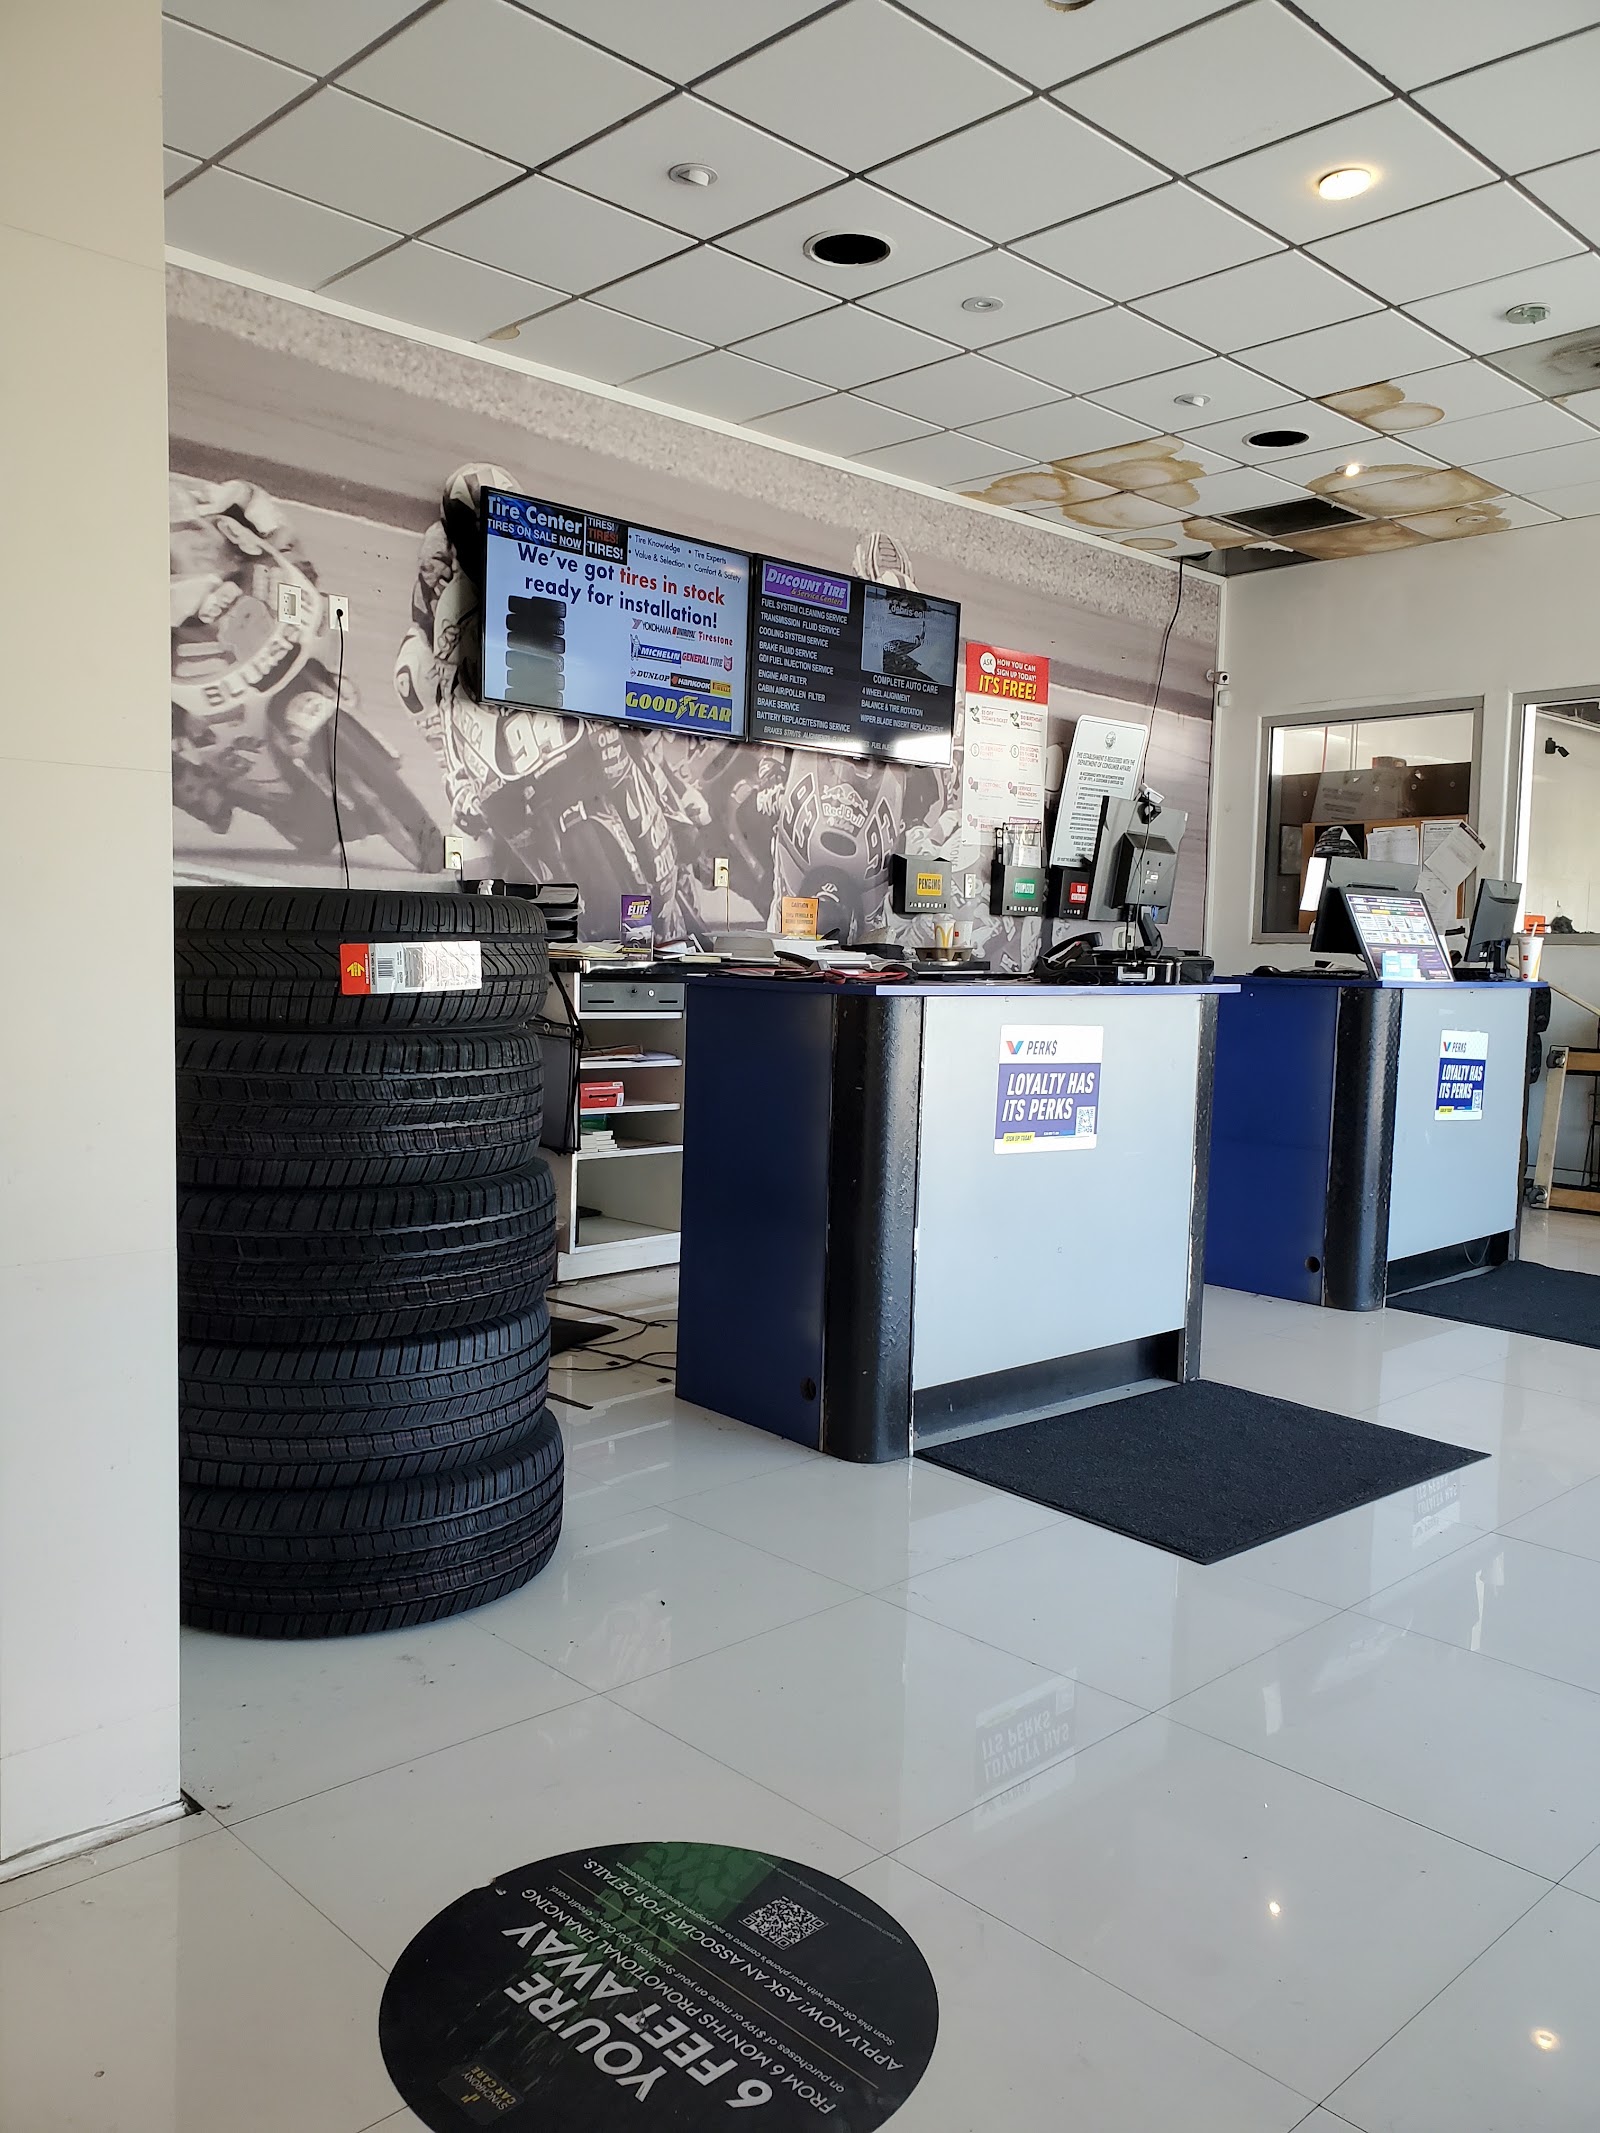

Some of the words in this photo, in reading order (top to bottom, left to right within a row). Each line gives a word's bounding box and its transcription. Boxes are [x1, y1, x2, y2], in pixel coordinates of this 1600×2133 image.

[487, 495, 520, 519] Tire
[526, 506, 583, 535] Center
[487, 518, 515, 534] TIRES
[516, 525, 532, 537] ON
[533, 529, 558, 544] SALE
[559, 535, 582, 549] NOW
[588, 528, 618, 544] TIRES!
[587, 540, 624, 560] TIRES!
[635, 534, 646, 544] Tire
[648, 538, 681, 554] Knowledge
[635, 549, 652, 561] Value
[660, 556, 685, 569] Selection
[694, 550, 705, 559] Tire
[706, 552, 726, 564] Experts
[518, 543, 578, 572] We've
[584, 563, 614, 581] got
[620, 567, 657, 591] tires
[663, 575, 677, 595] in
[683, 584, 725, 606] stock
[694, 563, 717, 576] Comfort
[723, 571, 741, 583] Safety
[766, 568, 822, 593] DISCOUNT
[822, 581, 847, 599] TIRE
[525, 577, 581, 604] ready
[587, 584, 613, 607] for
[620, 590, 717, 629] installation!
[797, 589, 819, 600] Service
[820, 594, 844, 606] Centers
[761, 598, 776, 608] FUEL
[776, 601, 799, 614] SYSTEM
[798, 606, 826, 620] CLEANING
[825, 612, 848, 625] SERVICE
[642, 621, 671, 635] YOKOHAMA
[698, 631, 733, 646] Firestone
[760, 611, 801, 628] TRANSMISSION
[802, 620, 818, 632] FLUID
[818, 624, 841, 637] SERVICE
[759, 626, 784, 639] COOLING
[784, 631, 807, 643] SYSTEM
[806, 635, 829, 648] SERVICE
[641, 647, 681, 661] MICHELIN
[682, 652, 709, 665] GENERAL
[759, 640, 779, 652] BRAKE
[778, 645, 795, 655] FLUID
[795, 648, 818, 660] SERVICE
[769, 656, 784, 666] FUEL
[783, 659, 812, 672] INJECTION
[812, 664, 834, 676] SERVICE
[983, 658, 993, 666] ASK
[996, 658, 1011, 668] HOW
[1011, 660, 1024, 670] YOU
[1023, 663, 1036, 672] CAN
[637, 670, 670, 682] DUNLOP
[758, 668, 779, 681] ENGINE
[779, 672, 789, 682] AIR
[789, 675, 808, 686] FILTER
[873, 674, 905, 689] COMPLETE
[906, 679, 922, 692] AUTO
[922, 683, 939, 695] CARE
[996, 668, 1010, 677] SIGN
[1010, 670, 1018, 679] UP
[1018, 672, 1037, 683] TODAY!
[757, 683, 775, 694] CABIN
[807, 691, 826, 703] FILTER
[866, 688, 883, 699] WHEEL
[883, 690, 911, 702] ALIGNMENT
[978, 674, 1000, 695] IT'S
[1002, 678, 1037, 701] FREE!
[626, 692, 732, 722] GOODYEAR
[757, 697, 776, 709] BRAKE
[777, 700, 800, 712] SERVICE
[861, 699, 885, 711] BALANCE
[889, 704, 900, 714] TIRE
[900, 705, 924, 717] ROTATION
[756, 710, 782, 723] BATTERY
[829, 722, 850, 733] SERVICE
[860, 713, 877, 725] WIPER
[877, 717, 893, 727] BLADE
[893, 719, 910, 730] INSERT
[627, 904, 649, 916] ELITE
[1441, 1064, 1470, 1081] LOYALTY
[1469, 1065, 1484, 1082] HAS
[1006, 1072, 1067, 1096] LOYALTY
[1066, 1072, 1095, 1095] HAS
[1438, 1082, 1451, 1099] ITS
[1450, 1082, 1473, 1099] PERKS
[1001, 1098, 1026, 1122] ITS
[1027, 1097, 1074, 1121] PERKS
[583, 1858, 639, 1897] DETAILS.
[616, 1861, 646, 1884] locations.
[643, 1880, 658, 1891] and
[568, 1897, 593, 1917] credit
[634, 1892, 666, 1915] FOR
[656, 1888, 684, 1908] benefits
[521, 1888, 600, 1944] FINANCING
[683, 1905, 715, 1926] program
[617, 1931, 632, 1945] Car
[661, 1911, 746, 1965] ASSOCIATE
[712, 1923, 726, 1935] see
[724, 1932, 734, 1940] to
[630, 1940, 677, 1976] Synchrony
[733, 1938, 762, 1958] camera
[501, 1921, 638, 2000] AWAY
[761, 1955, 791, 1977] phone's
[597, 1939, 703, 2017] PROMOTIONAL
[674, 1972, 698, 1991] your
[740, 1963, 770, 1982] AN
[788, 1972, 808, 1988] your
[695, 1986, 709, 1997] on
[764, 1979, 803, 2003] ASK
[806, 1984, 824, 1999] with
[707, 1995, 733, 2015] more
[824, 1997, 845, 2012] code
[731, 2012, 744, 2022] or
[797, 2001, 851, 2038] NOW!
[843, 2009, 858, 2021] QR
[857, 2017, 874, 2032] this
[503, 1971, 668, 2103] YOU'RE
[741, 2021, 766, 2039] $199
[872, 2028, 896, 2047] Scan
[614, 2003, 739, 2086] FEET
[698, 2013, 773, 2069] MONTHS
[763, 2035, 778, 2046] of
[777, 2043, 830, 2083] purchases
[845, 2035, 904, 2071] APPLY
[470, 2066, 498, 2089] CARE
[769, 2064, 786, 2076] 6
[461, 2071, 508, 2110] SYNCHRONY
[495, 2087, 517, 2105] CAR
[725, 2079, 773, 2109] 6
[781, 2073, 837, 2115] FROM
[829, 2080, 845, 2093] on
